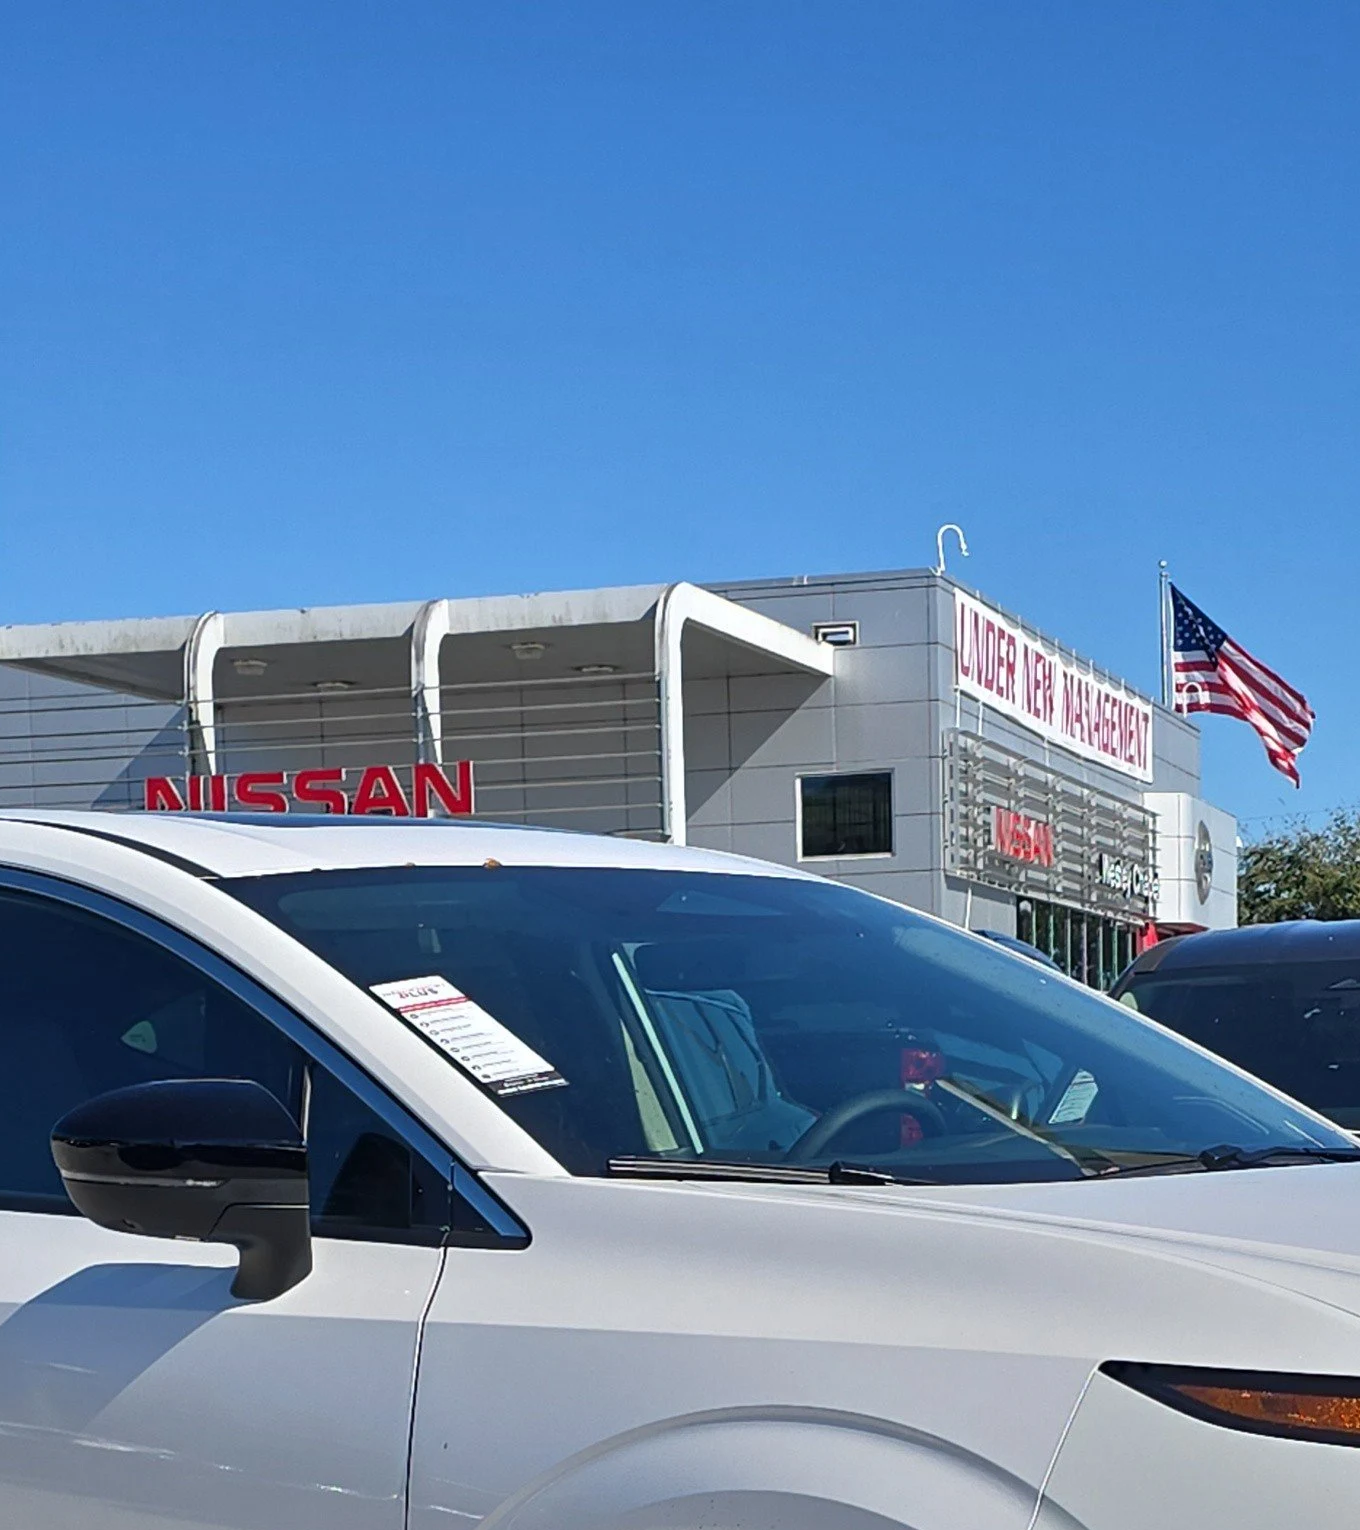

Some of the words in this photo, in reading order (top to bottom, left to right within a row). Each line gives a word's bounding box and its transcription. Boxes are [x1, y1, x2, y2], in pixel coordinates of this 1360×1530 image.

[960, 602, 1016, 704] UNDER
[1022, 643, 1056, 726] NEW
[1060, 669, 1150, 771] MANAGEMENT
[144, 760, 476, 818] NISSAN
